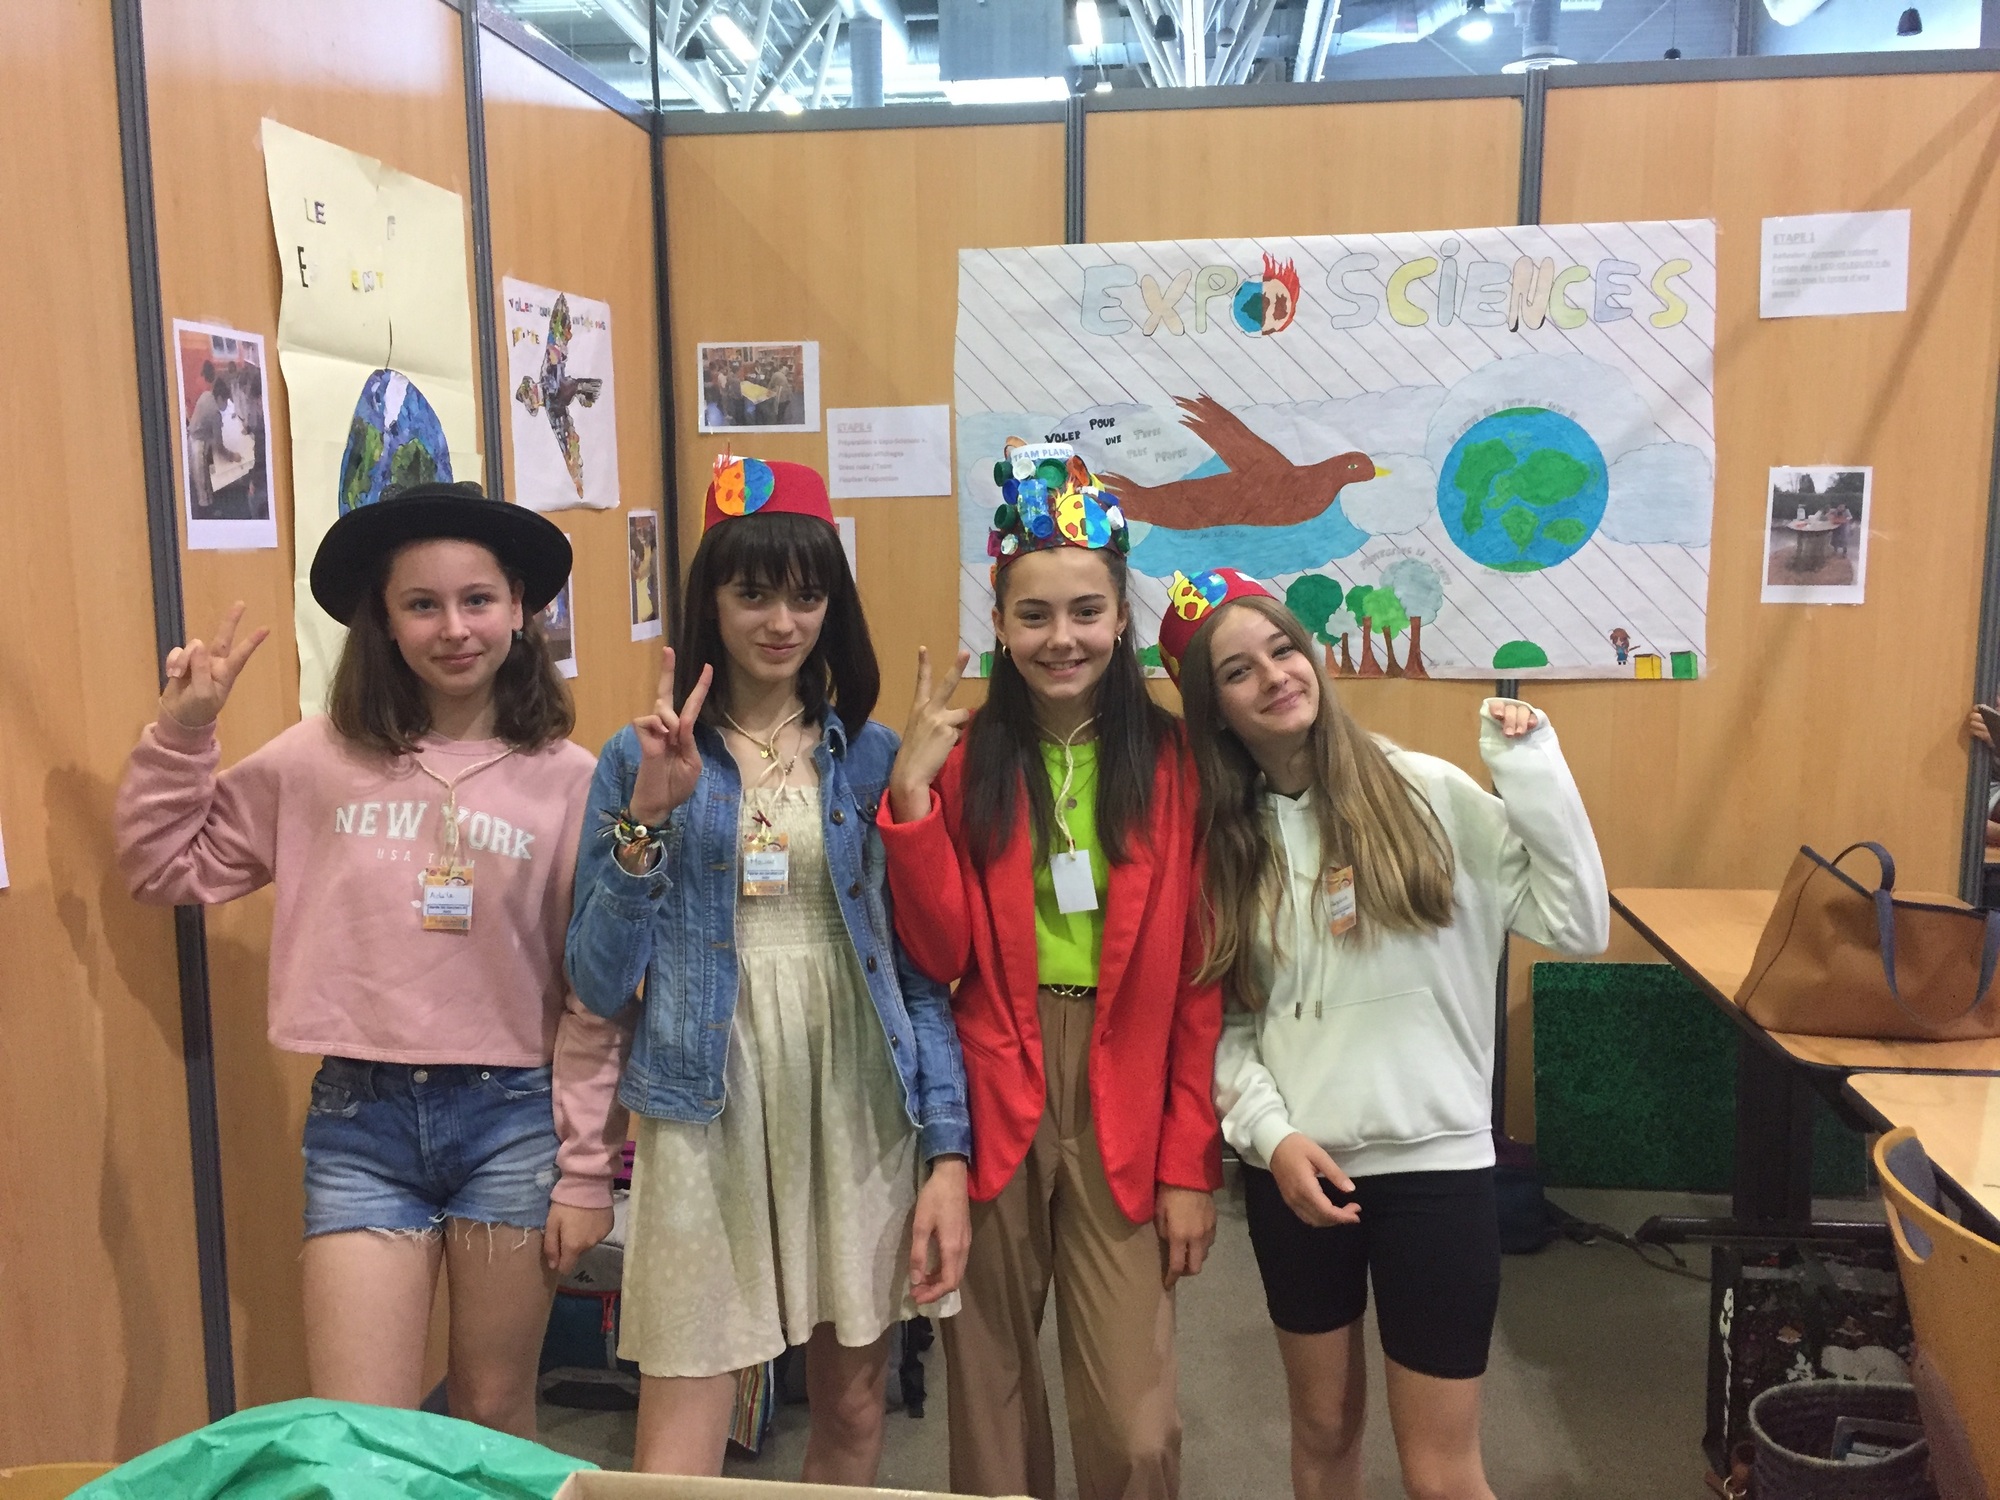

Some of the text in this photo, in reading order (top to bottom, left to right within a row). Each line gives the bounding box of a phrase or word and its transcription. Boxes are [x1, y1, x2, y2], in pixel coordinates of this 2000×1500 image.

[1080, 254, 1300, 338] EXPO
[1089, 417, 1116, 430] POUR
[1044, 430, 1081, 444] VOLER
[1105, 434, 1122, 446] UNE
[1013, 450, 1040, 462] TEAM
[335, 800, 536, 860] NEW YORK
[377, 848, 412, 863] USA
